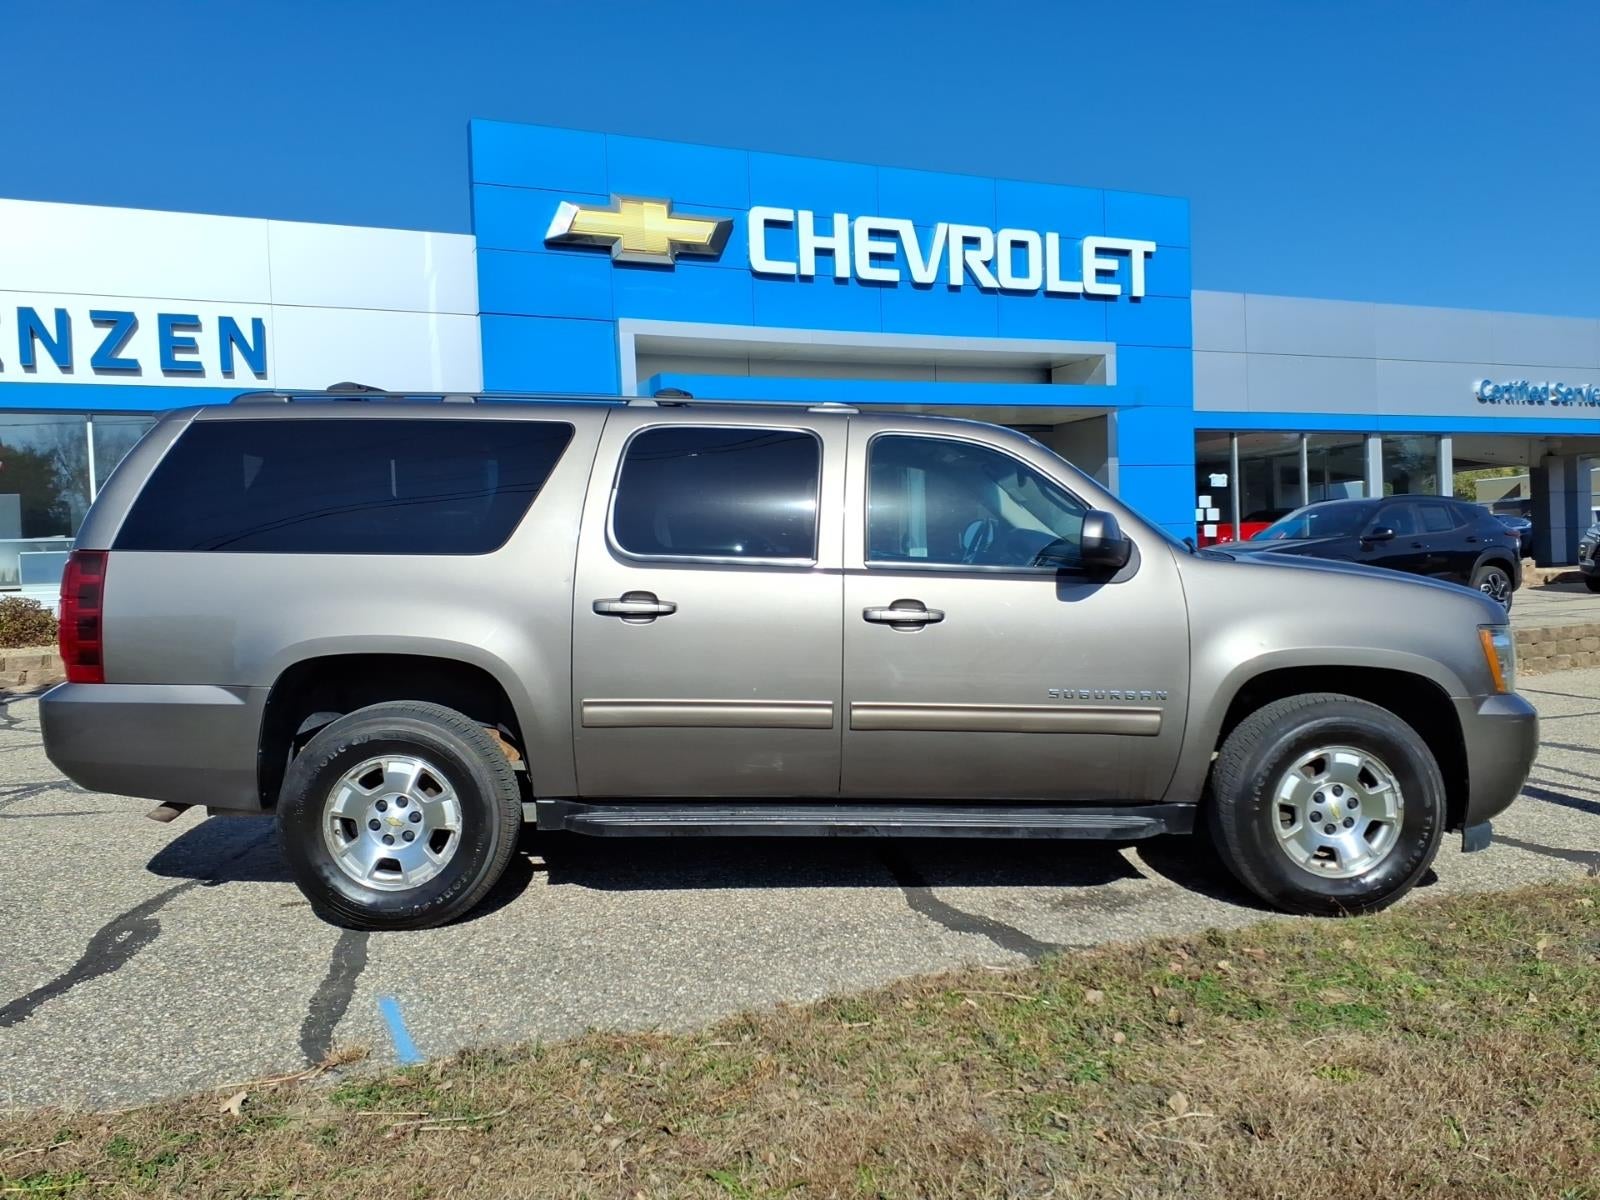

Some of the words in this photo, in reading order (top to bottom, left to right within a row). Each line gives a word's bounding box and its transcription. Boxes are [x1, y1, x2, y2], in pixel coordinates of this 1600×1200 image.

[748, 206, 1157, 297] CHEVROLET
[0, 306, 267, 380] NZEN
[1479, 379, 1549, 402] Certified
[1048, 688, 1168, 701] SUBURBAN
